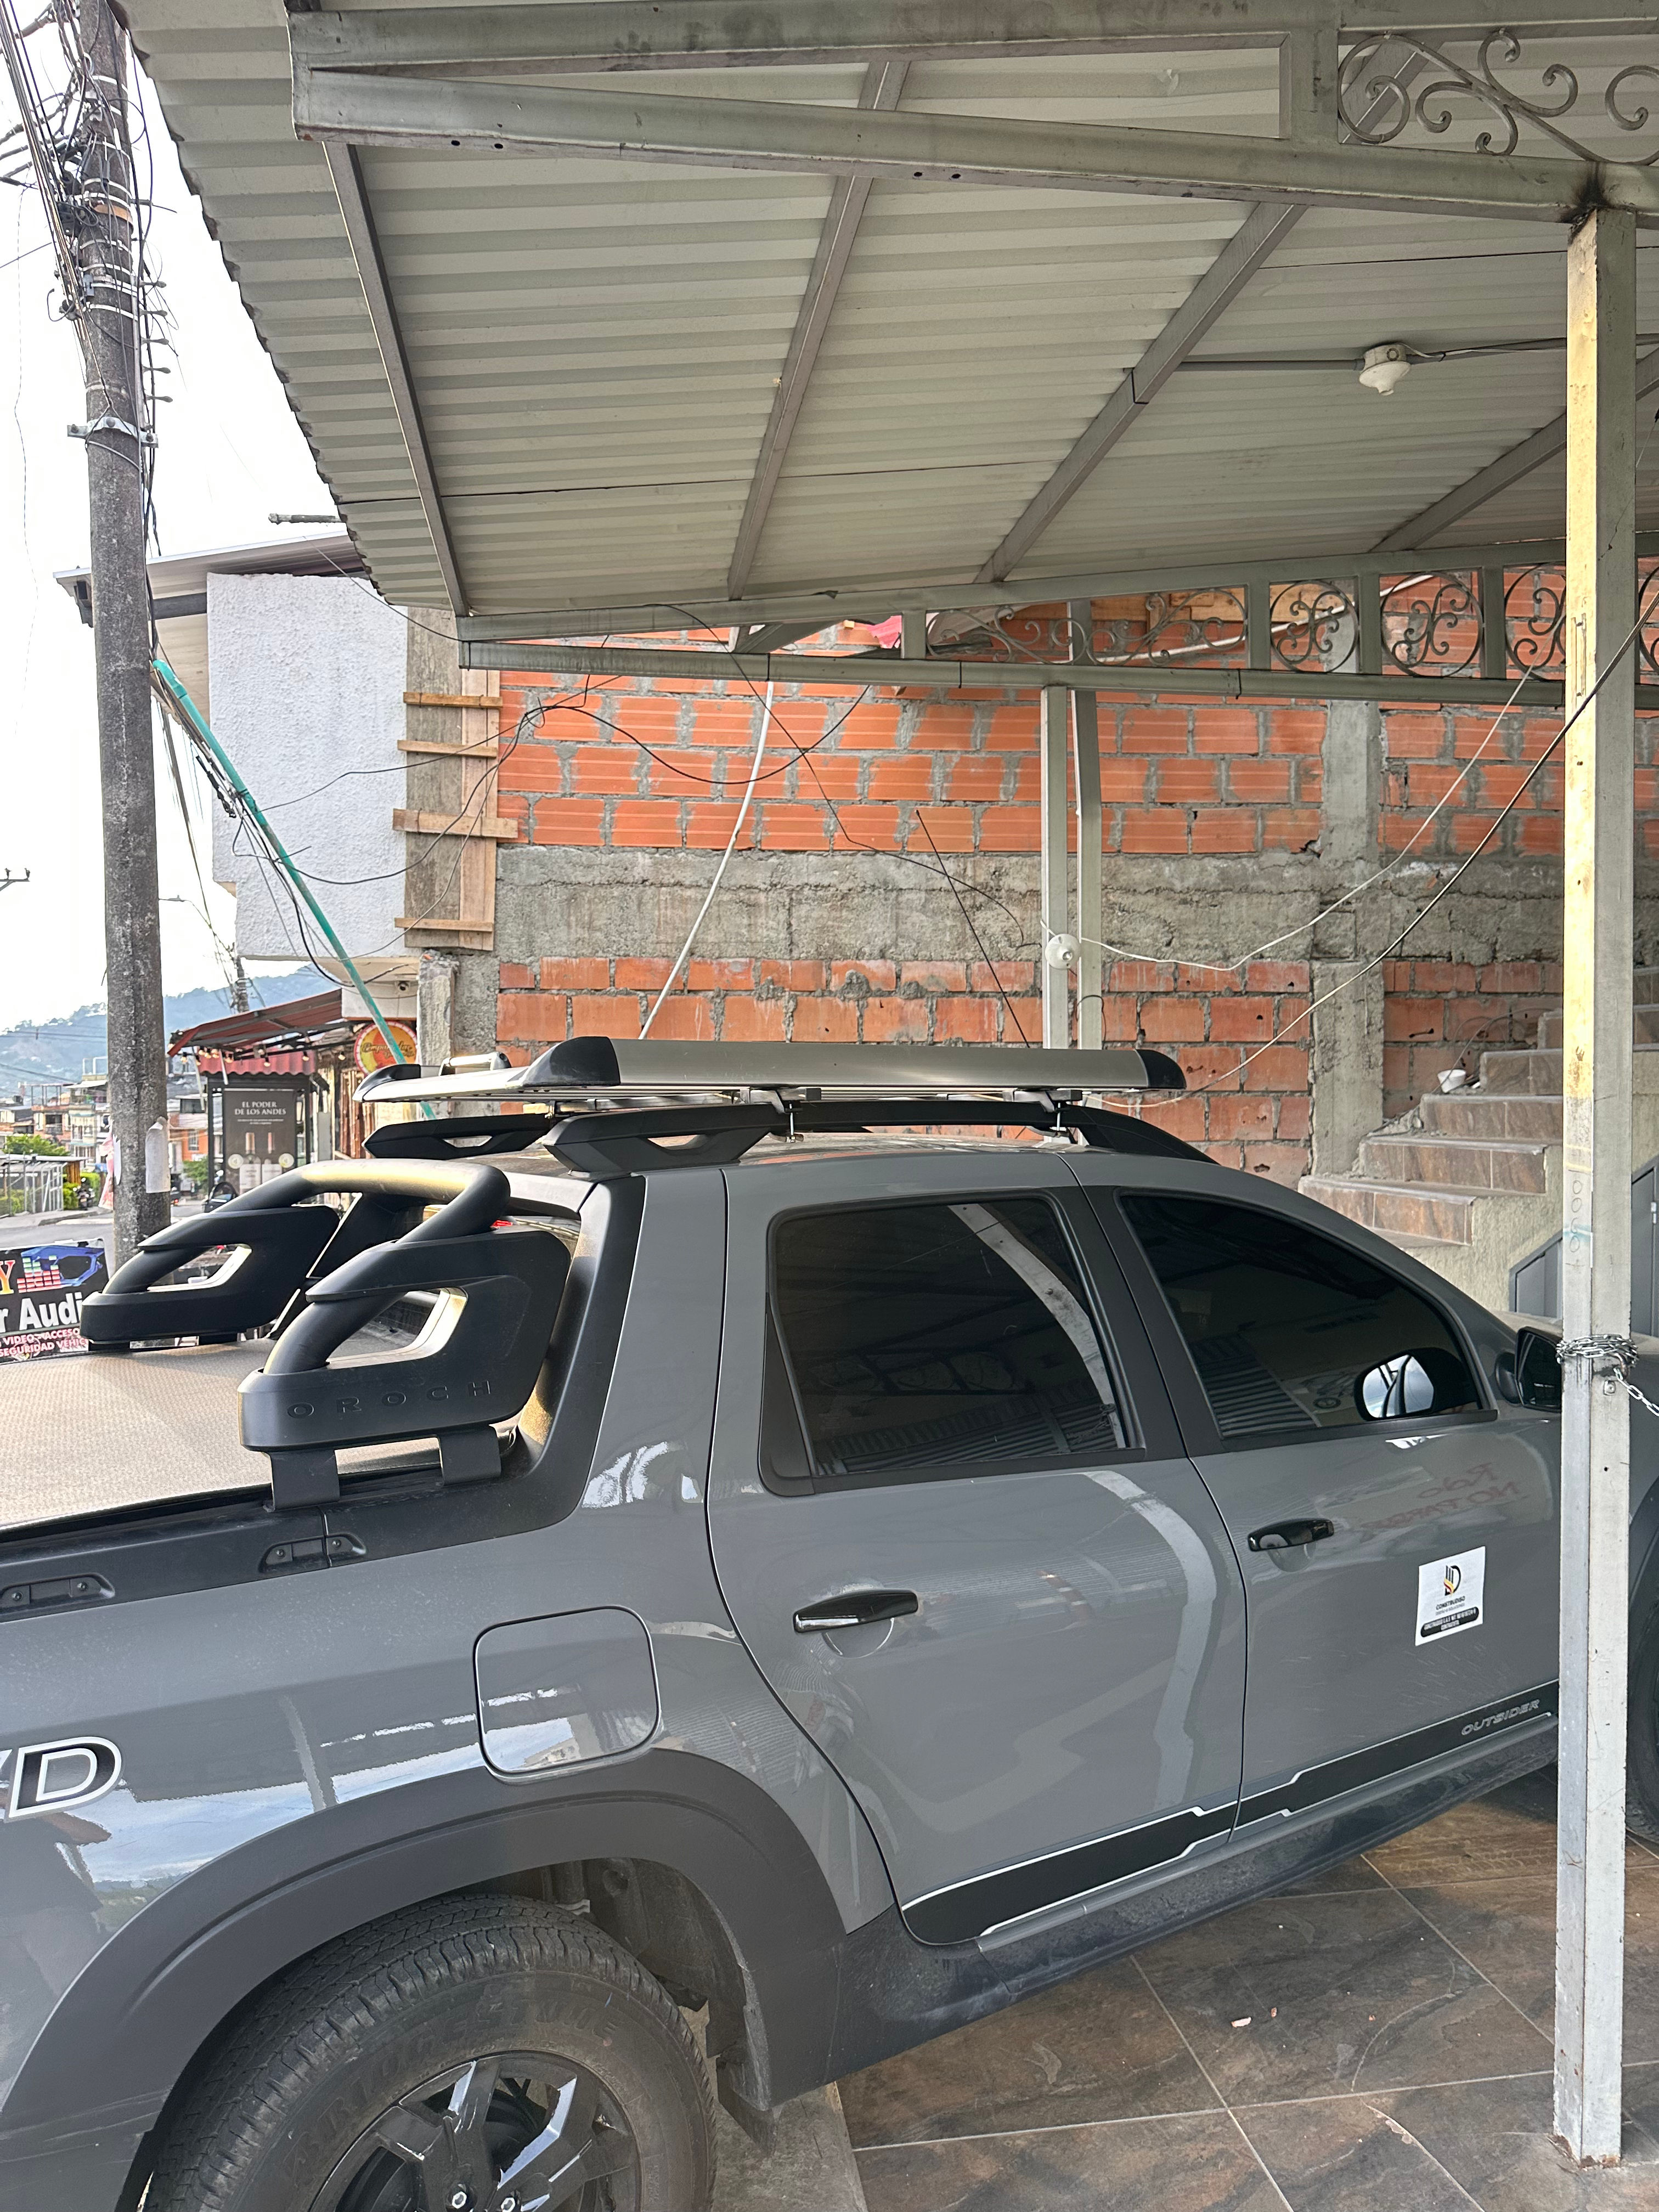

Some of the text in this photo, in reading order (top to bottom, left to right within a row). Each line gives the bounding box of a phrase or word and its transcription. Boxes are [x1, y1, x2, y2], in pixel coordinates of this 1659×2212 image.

[0, 1342, 55, 1356] SEGURIDAD
[3, 1334, 35, 1345] VIDEO
[287, 1379, 492, 1419] OROCH
[1461, 1699, 1541, 1736] OUTSIDER
